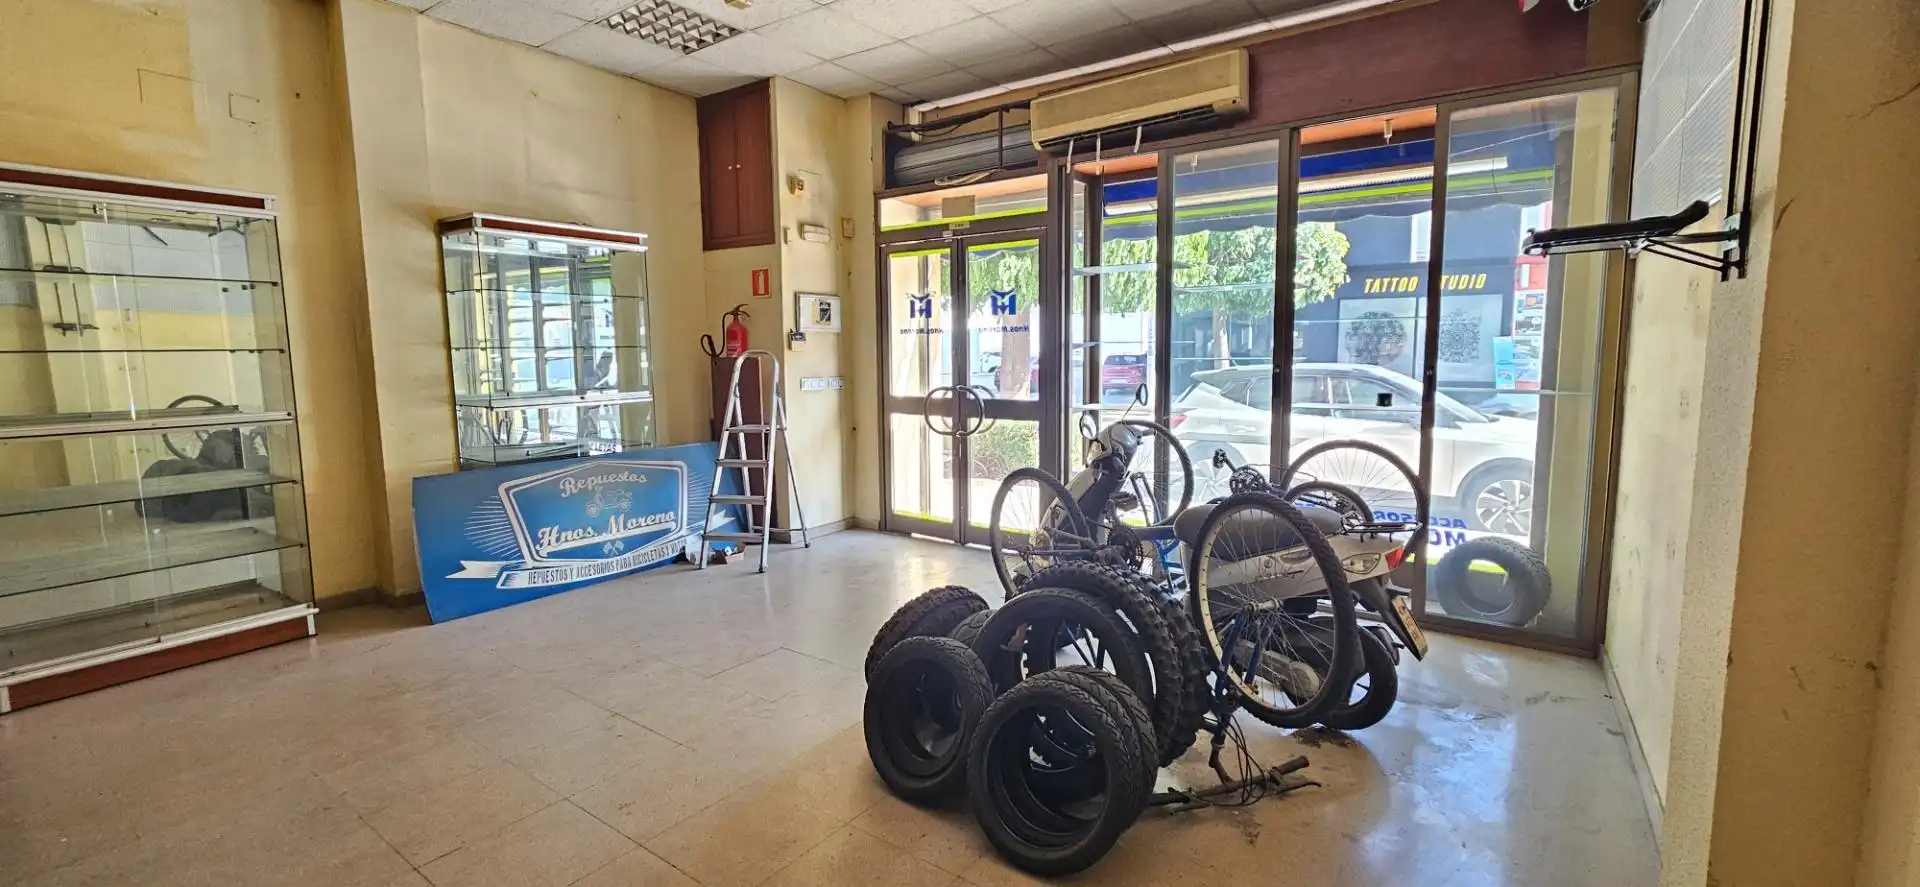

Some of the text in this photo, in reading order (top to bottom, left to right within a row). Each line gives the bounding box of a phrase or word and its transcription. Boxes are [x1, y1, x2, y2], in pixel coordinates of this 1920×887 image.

[1364, 273, 1487, 293] TATTOO TUDIO
[559, 470, 648, 498] Repuestos
[535, 511, 677, 550] Hnos. Moreno
[528, 569, 568, 585] REPUESTOS
[570, 568, 575, 580] Y
[576, 559, 615, 578] ACCESORIOS
[616, 554, 632, 572] PARA
